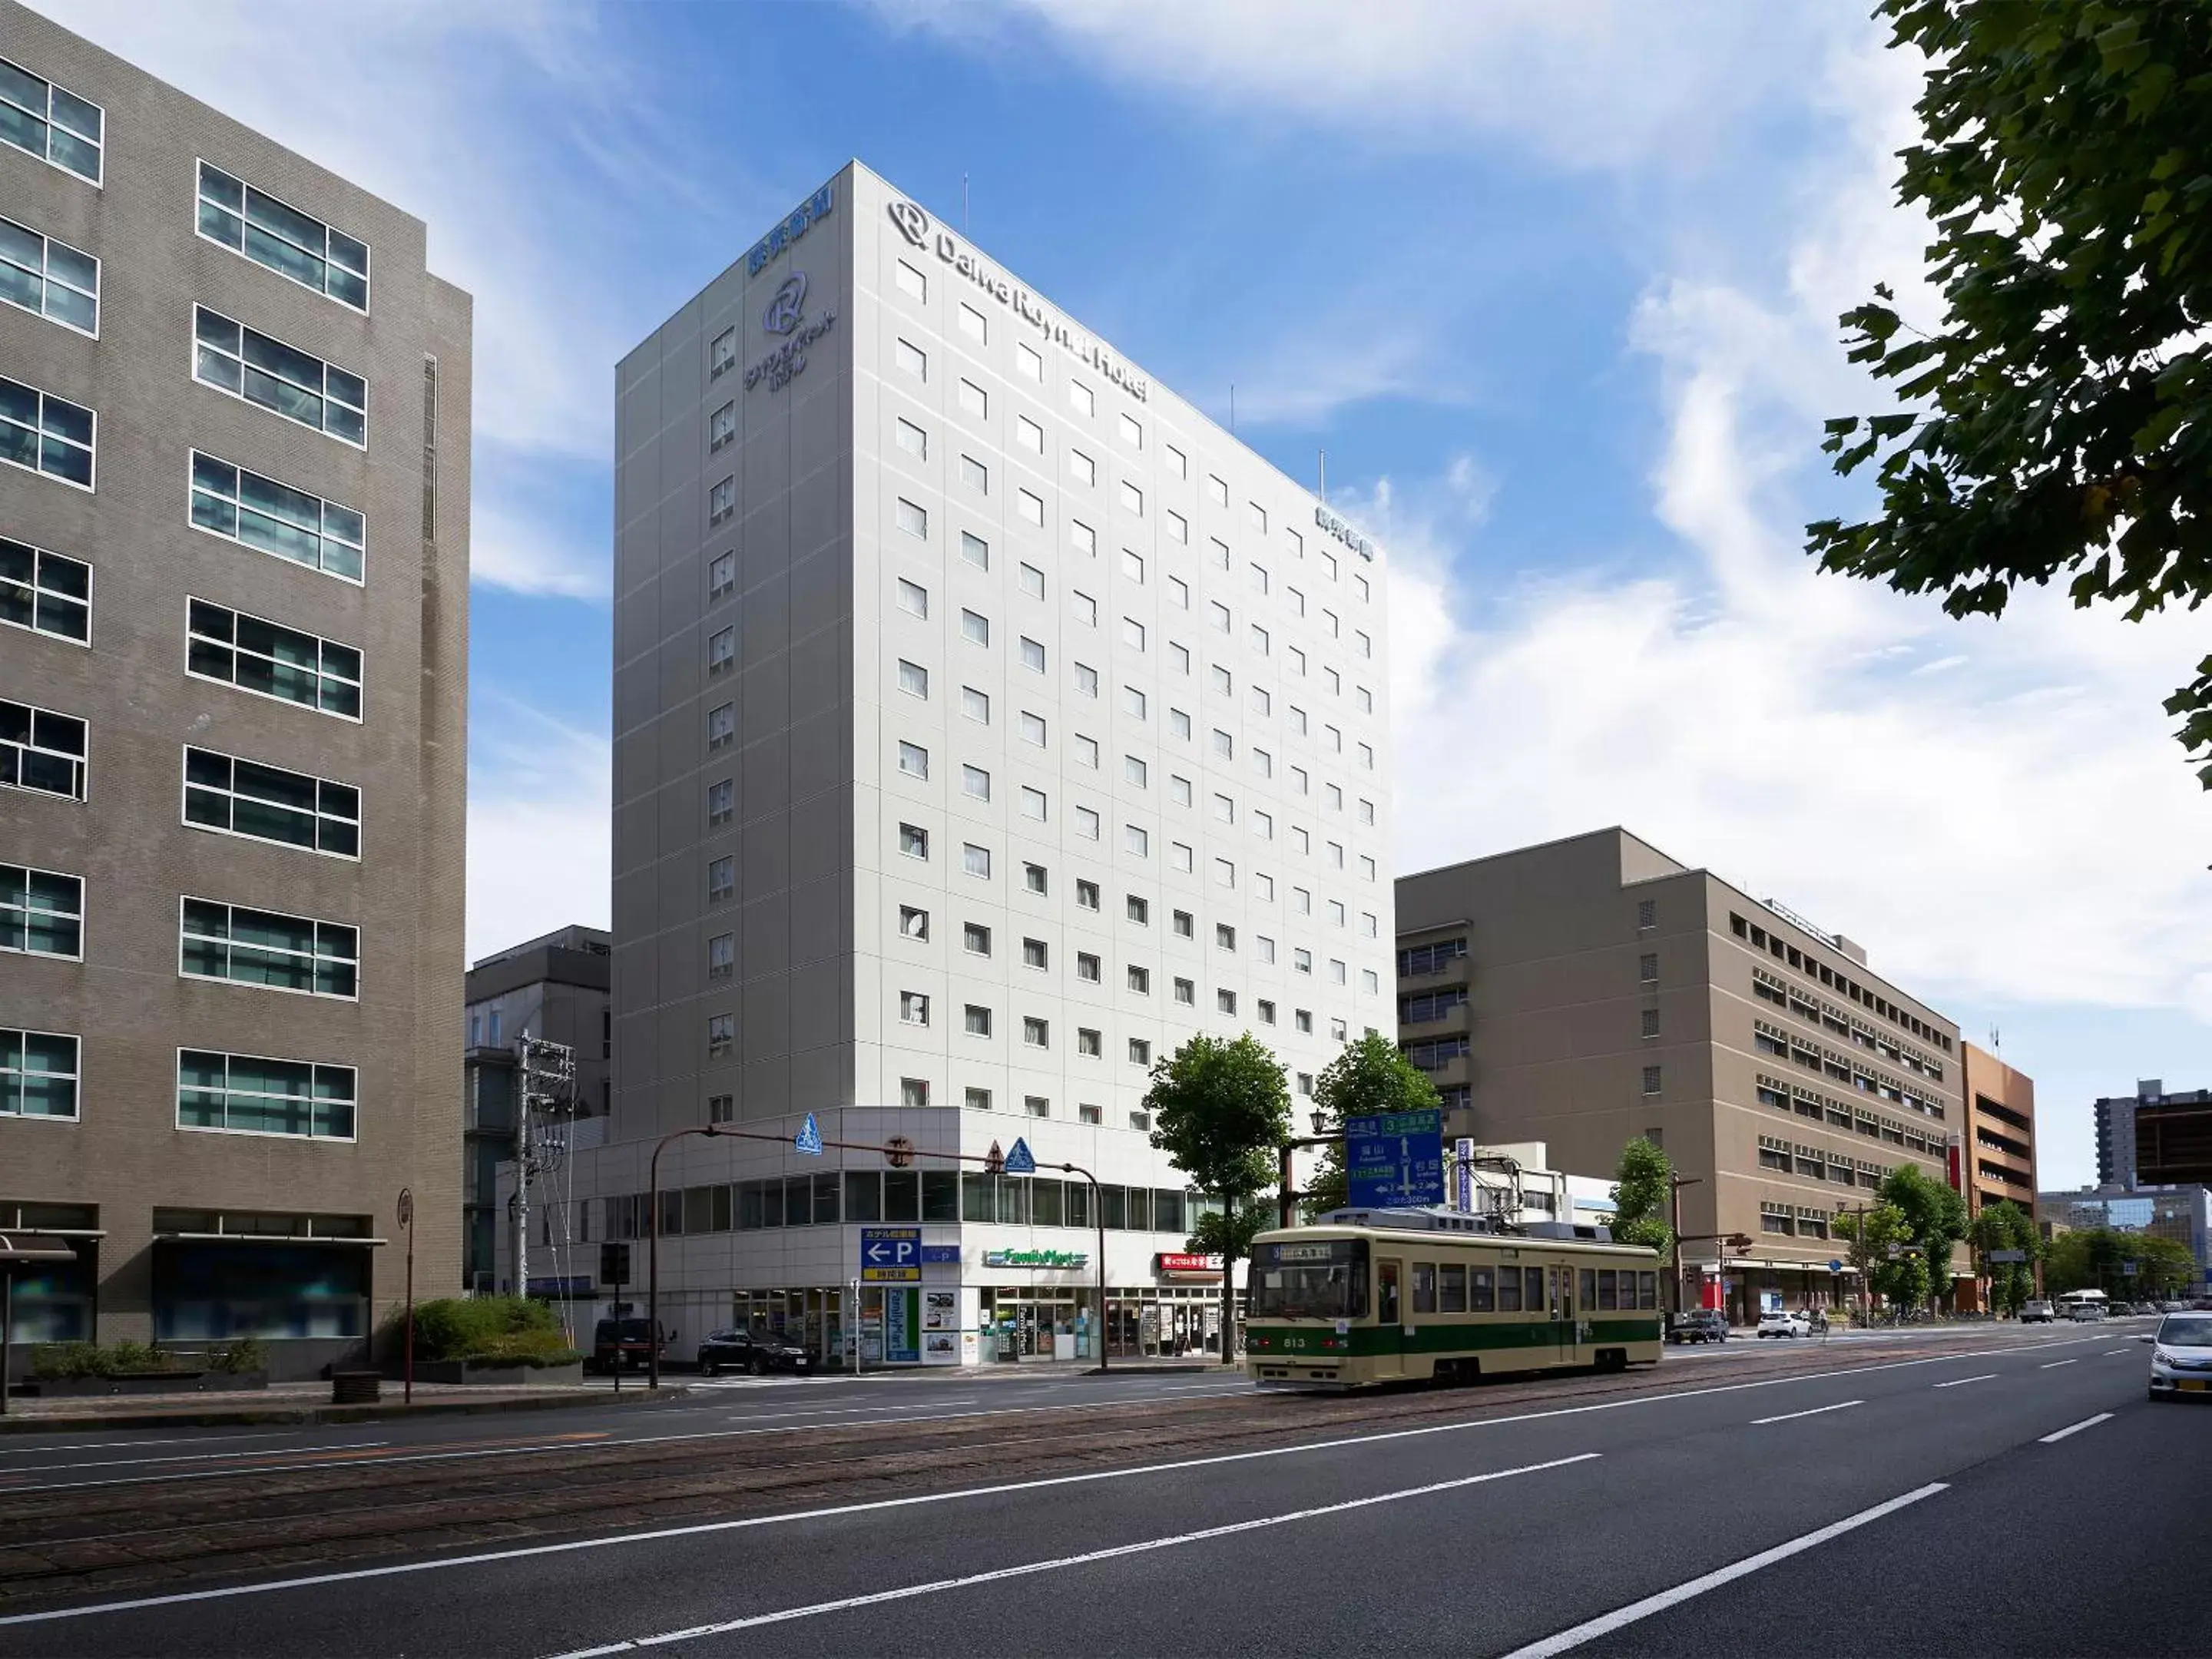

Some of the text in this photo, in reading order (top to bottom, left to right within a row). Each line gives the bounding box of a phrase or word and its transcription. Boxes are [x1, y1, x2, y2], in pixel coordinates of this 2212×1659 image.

[936, 233, 1008, 304] Daiwa
[897, 1241, 913, 1263] P
[1003, 1247, 1074, 1265] FamilyMart
[889, 1289, 904, 1349] FamilyMart
[1019, 1307, 1028, 1355] FamilyMart
[1283, 1338, 1306, 1348] 813
